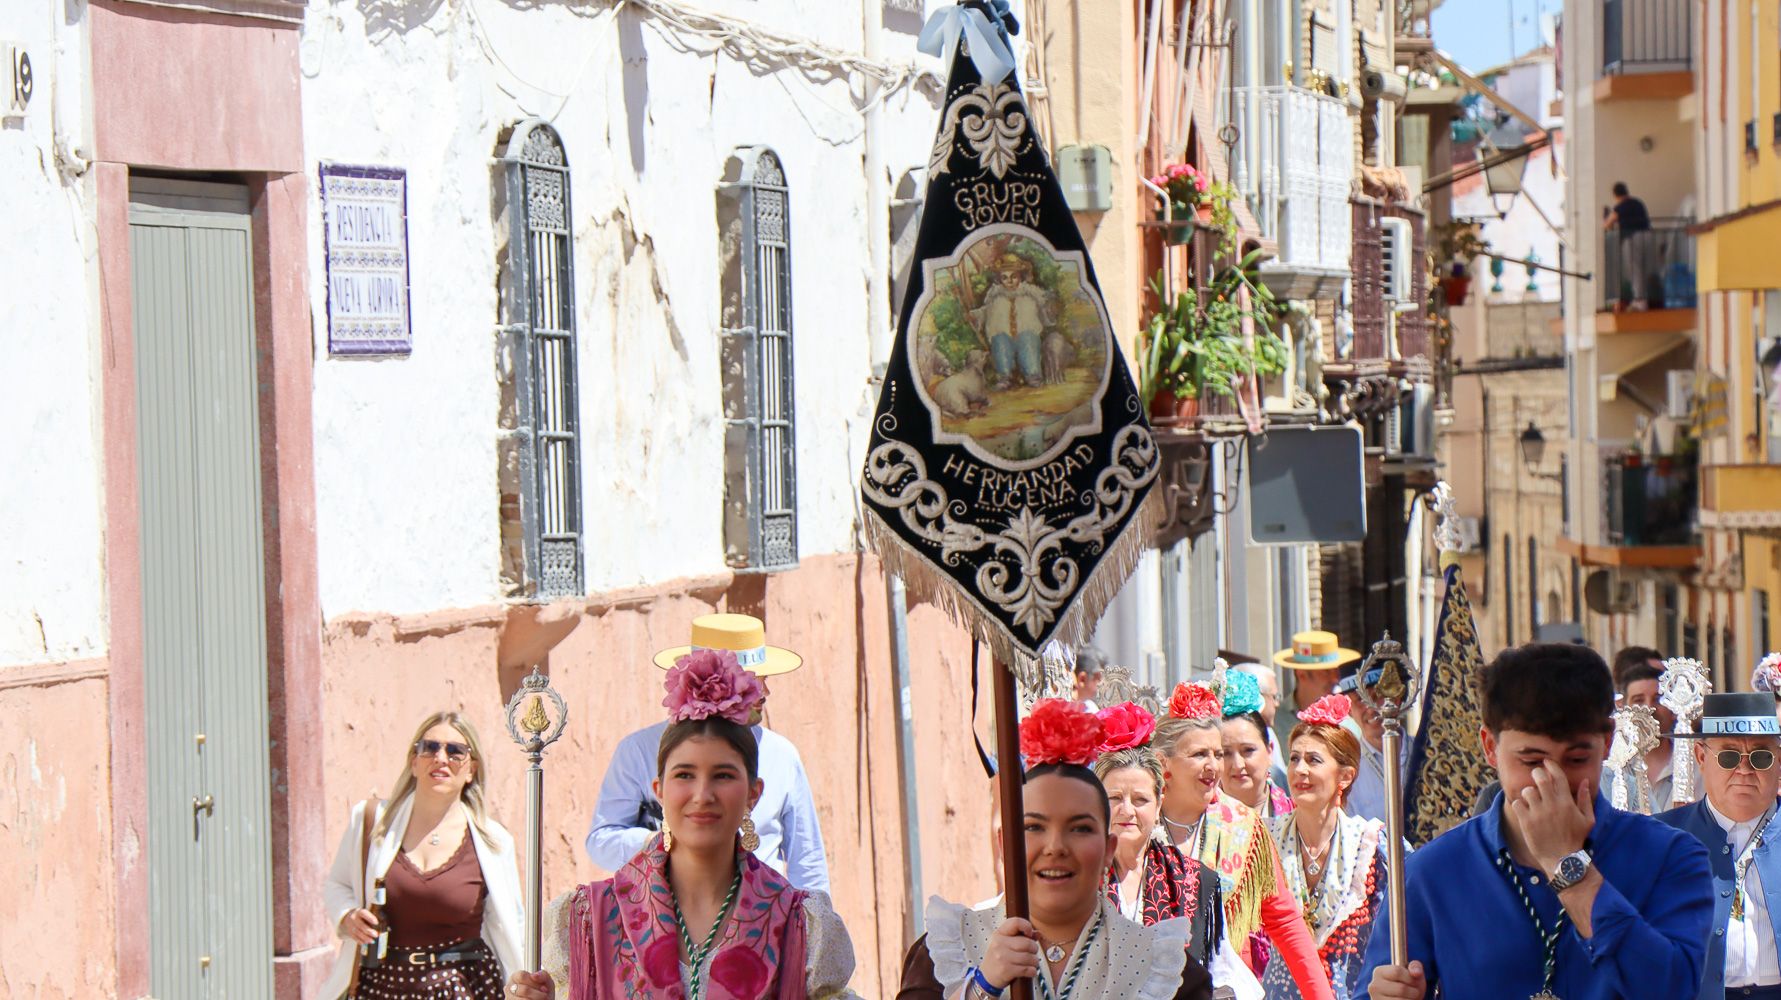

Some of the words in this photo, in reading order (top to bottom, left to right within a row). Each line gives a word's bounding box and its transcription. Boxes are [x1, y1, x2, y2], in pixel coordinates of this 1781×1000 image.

[13, 46, 33, 103] 19
[954, 182, 1041, 212] GRUPO
[337, 205, 393, 242] RESIDENCIA
[961, 203, 1041, 231] JOVEN
[334, 276, 361, 313] NUEVA
[368, 276, 400, 314] AURORA
[943, 444, 1094, 492] HERMANDAD
[977, 480, 1077, 509] LUCENA
[1715, 720, 1775, 734] LUCENA
